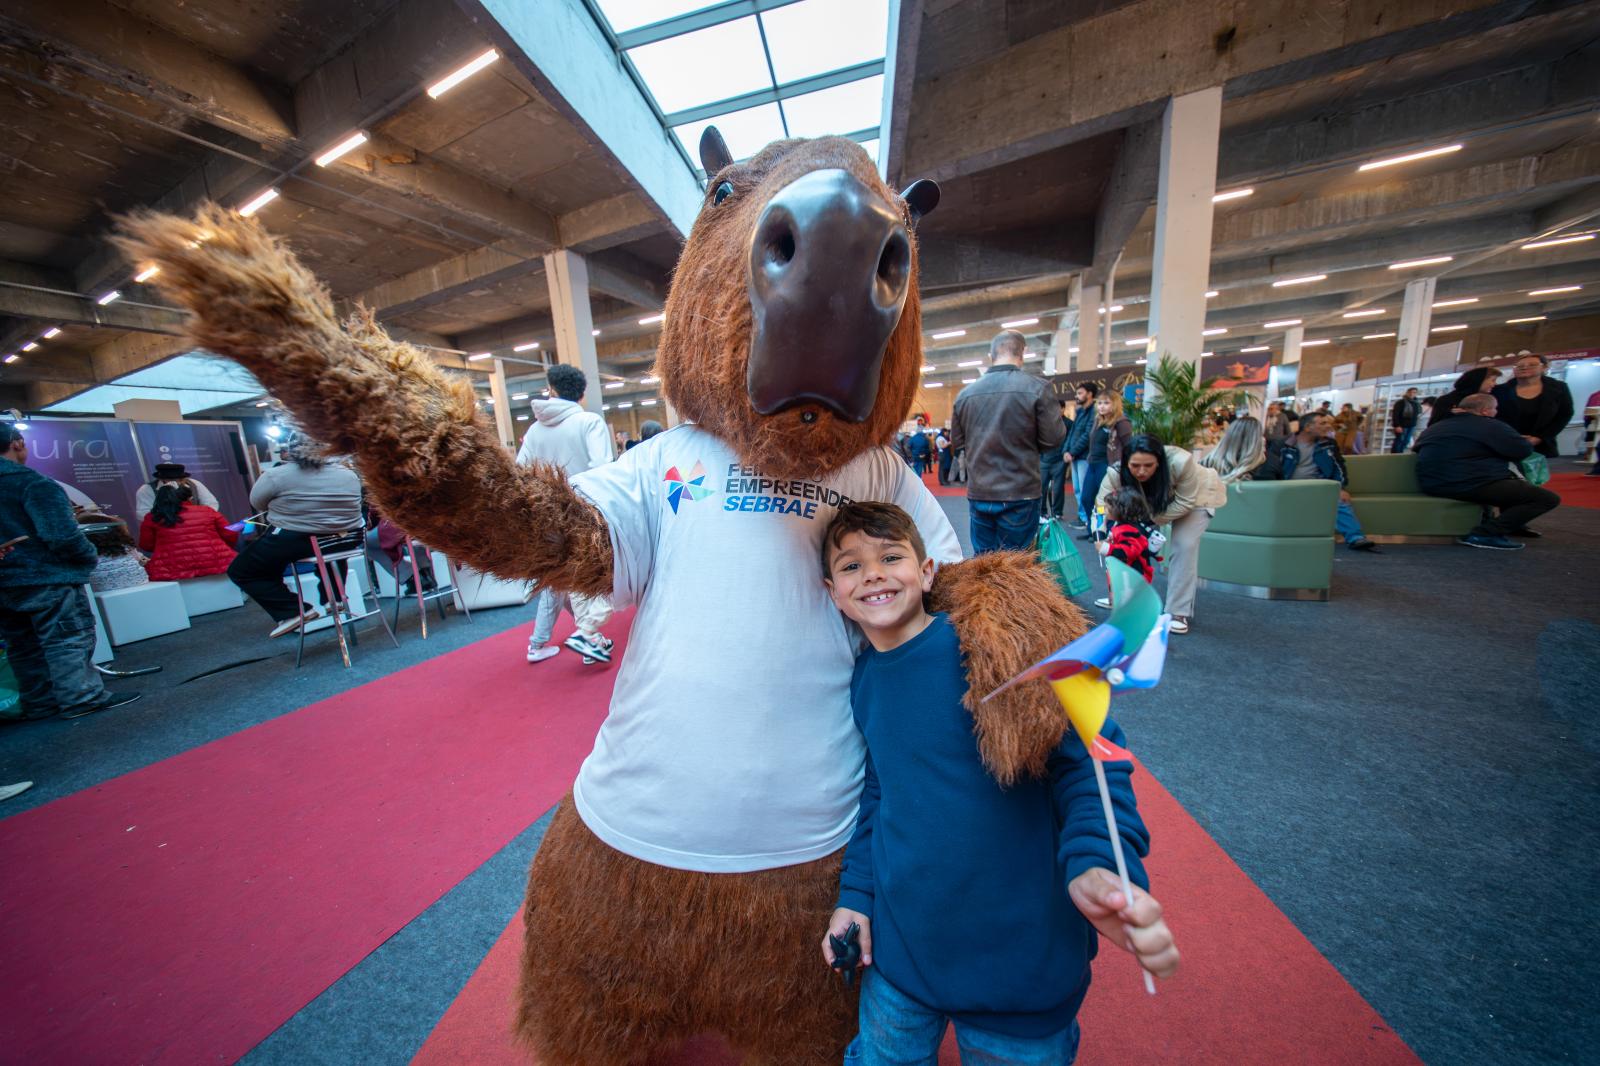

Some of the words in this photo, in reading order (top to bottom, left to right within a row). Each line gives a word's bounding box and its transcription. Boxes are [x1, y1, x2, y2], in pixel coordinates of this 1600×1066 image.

[727, 463, 763, 477] FEI
[725, 478, 856, 511] EMPREENDE
[723, 495, 818, 520] SEBRAE
